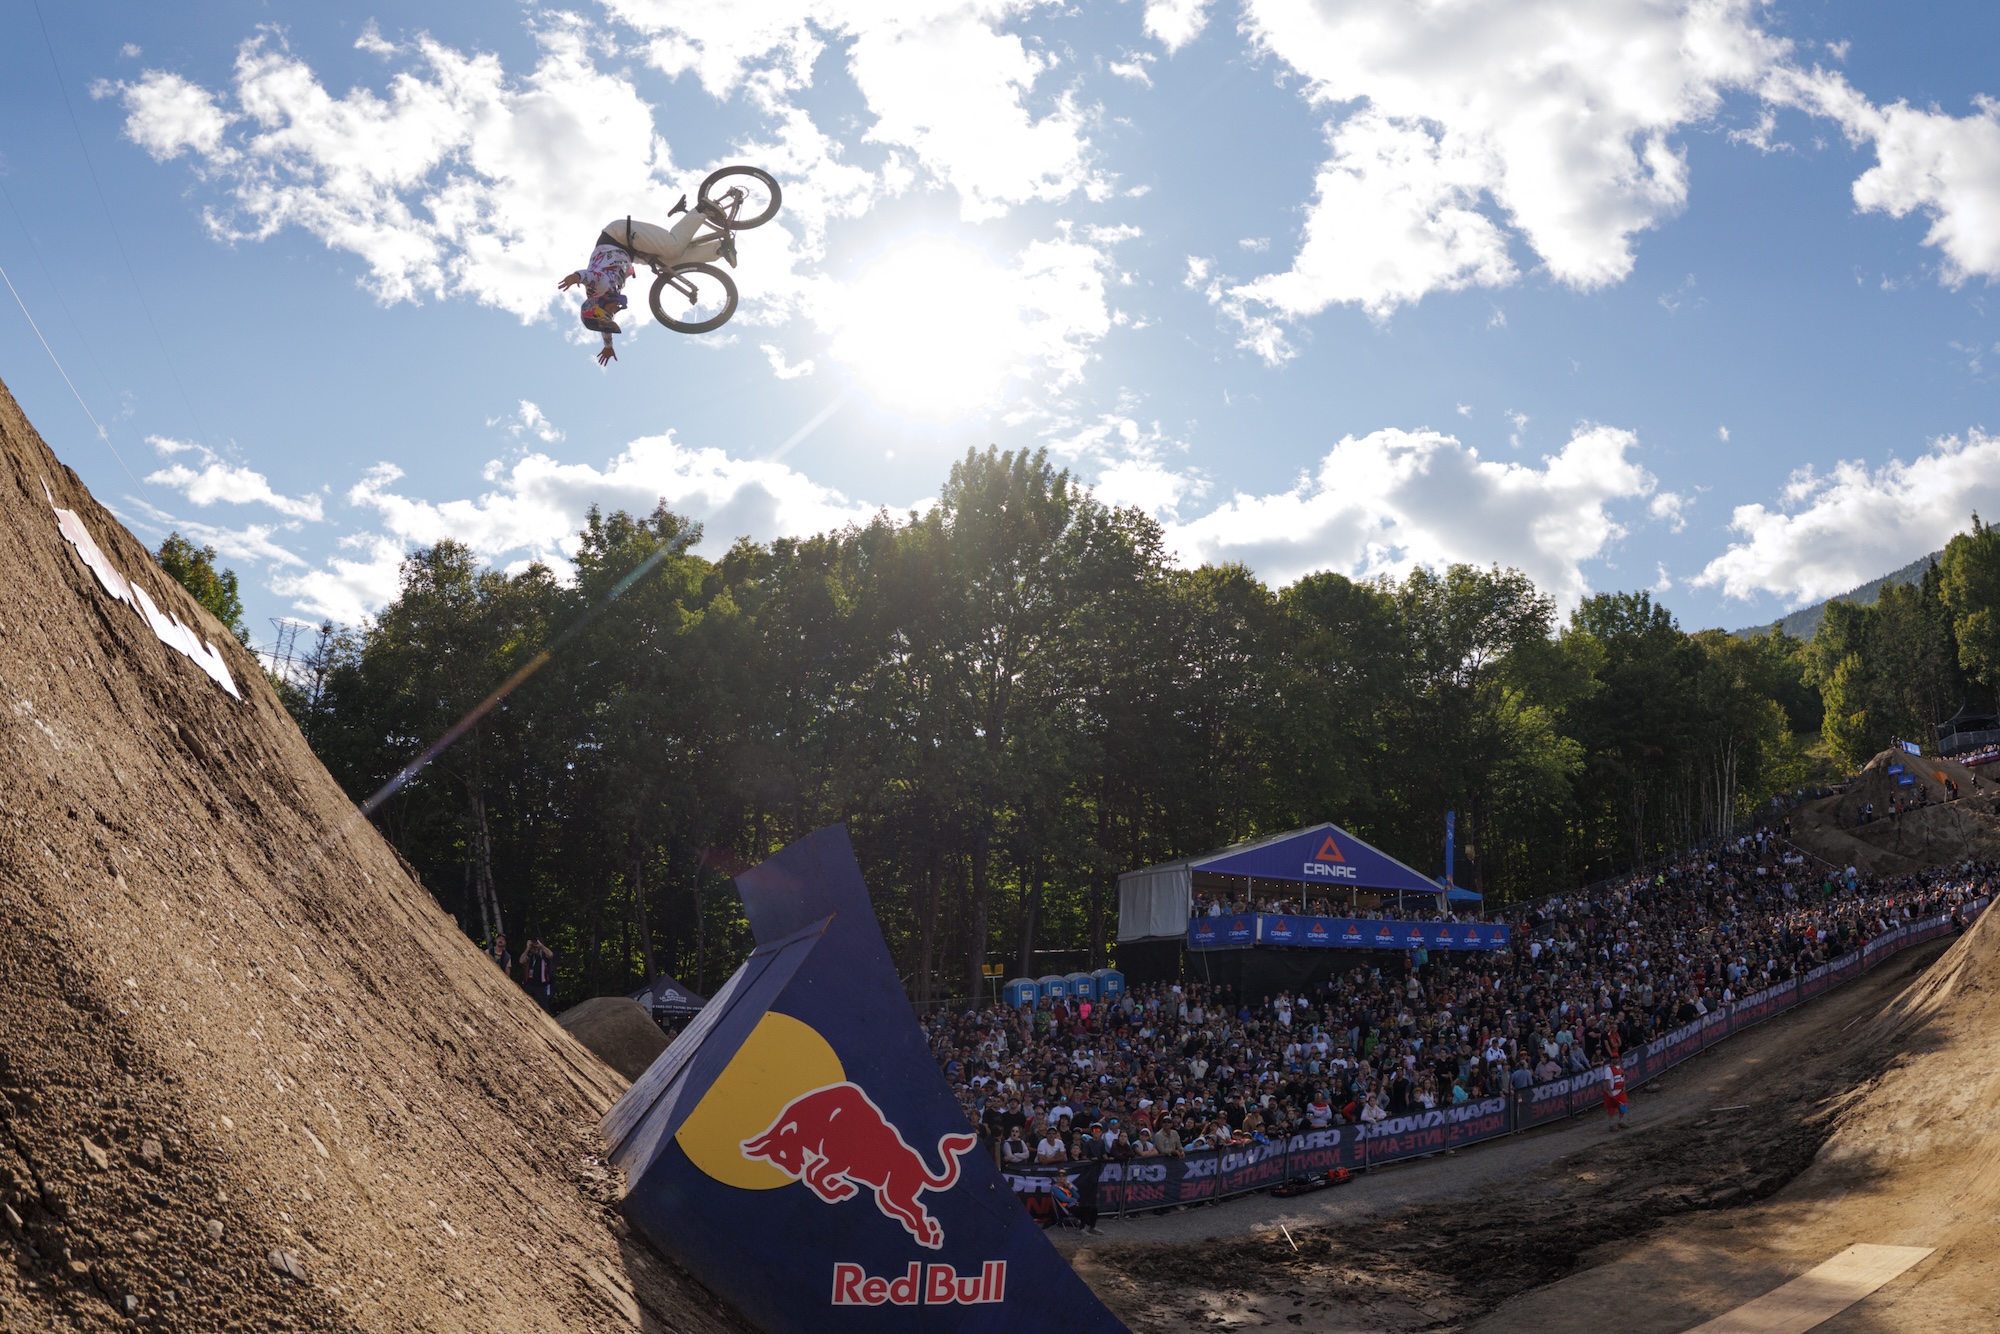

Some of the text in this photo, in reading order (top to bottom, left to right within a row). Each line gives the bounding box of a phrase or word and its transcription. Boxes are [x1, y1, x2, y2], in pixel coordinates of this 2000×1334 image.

[1303, 863, 1357, 878] CANAC
[832, 1260, 1007, 1306] Red Bull
